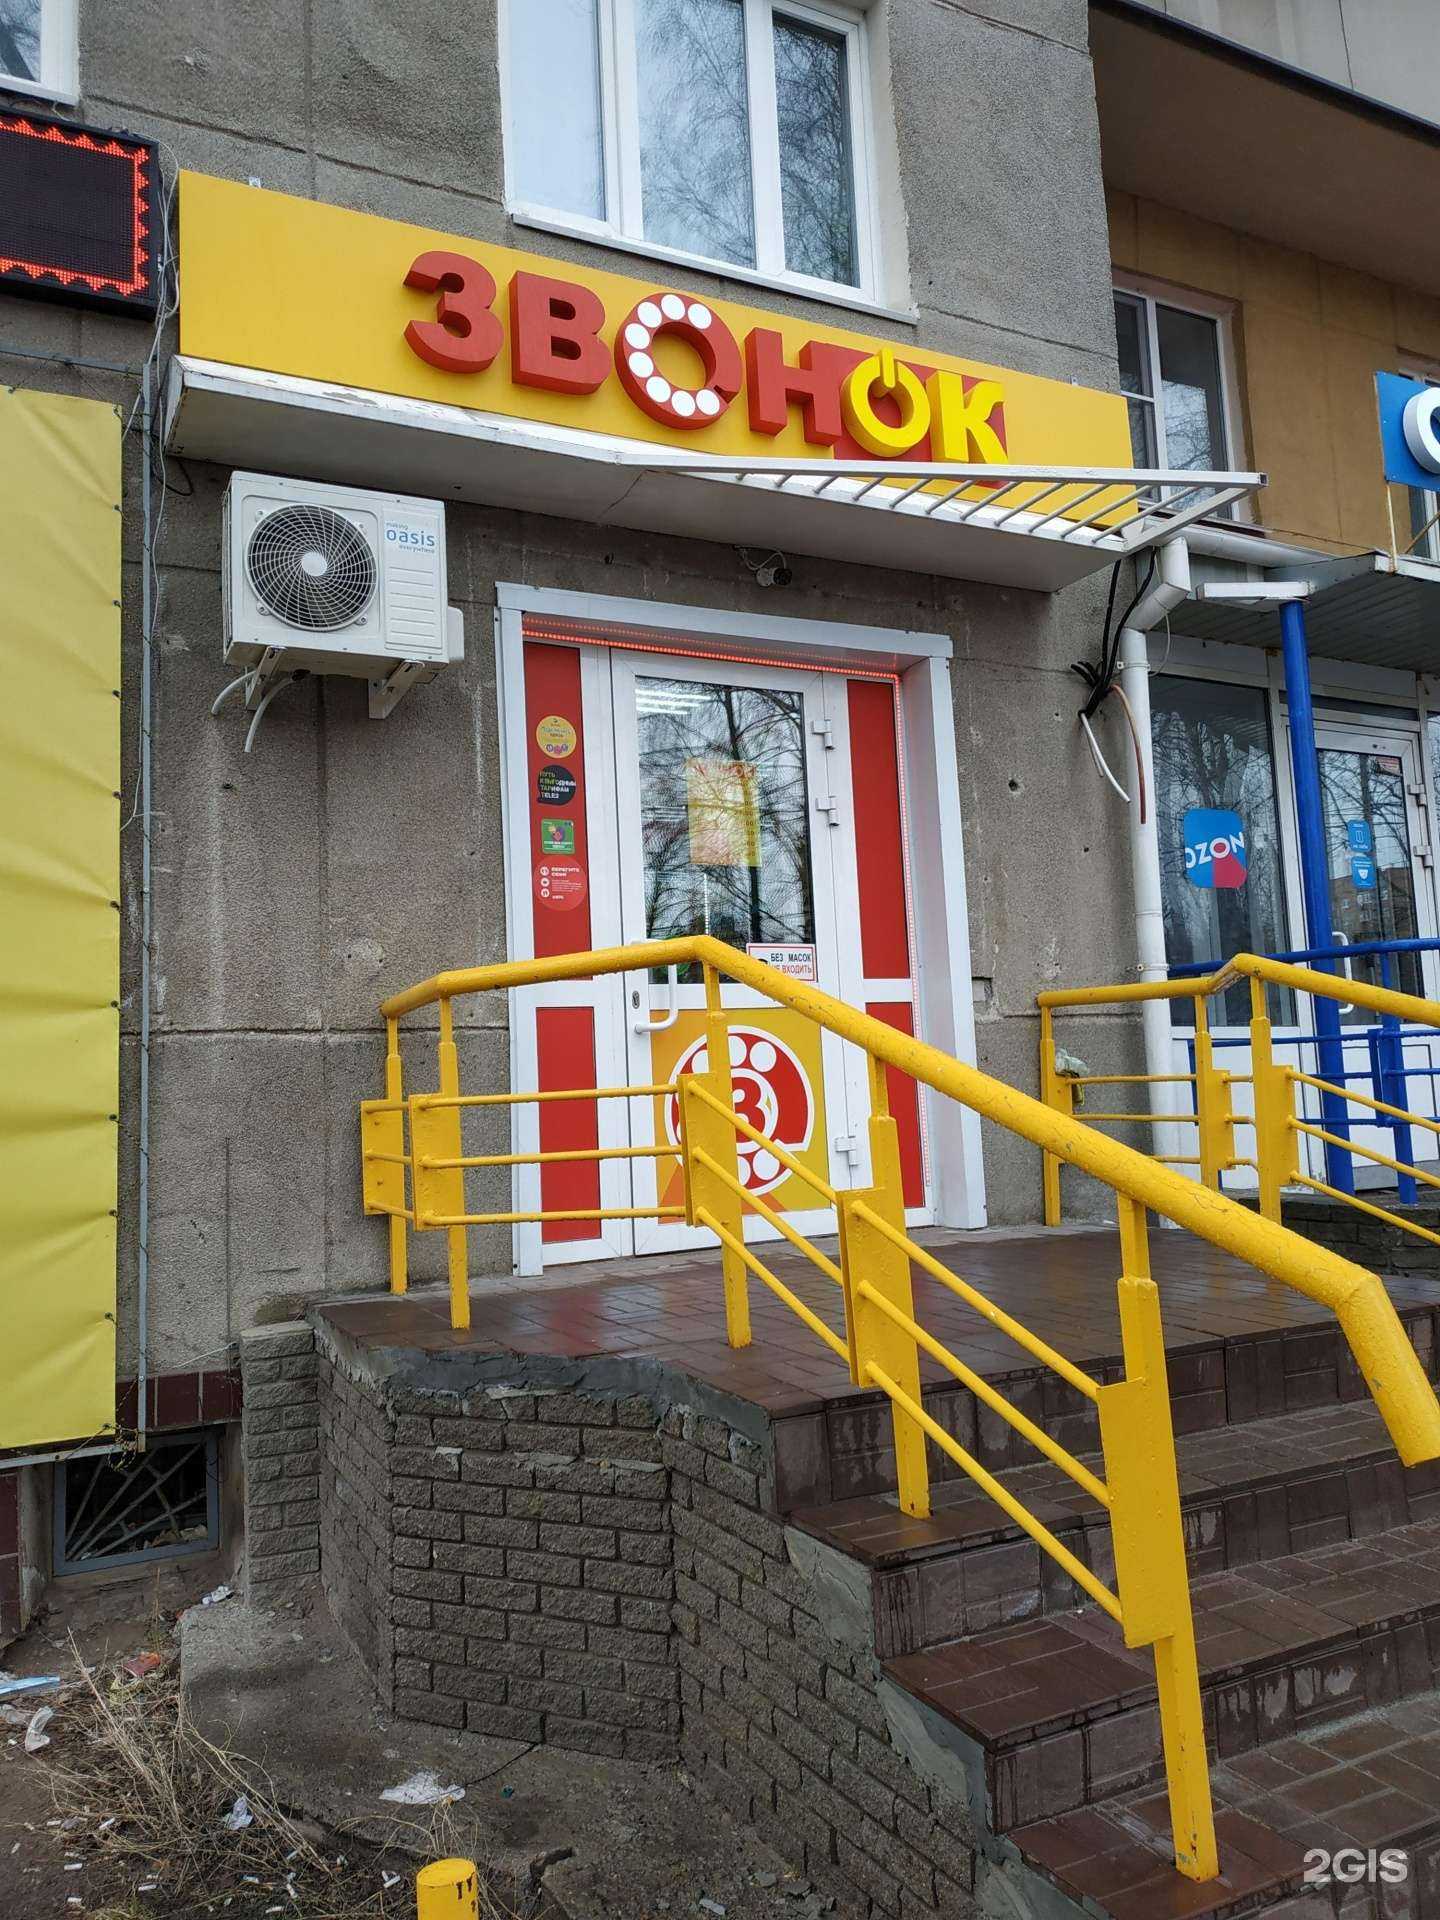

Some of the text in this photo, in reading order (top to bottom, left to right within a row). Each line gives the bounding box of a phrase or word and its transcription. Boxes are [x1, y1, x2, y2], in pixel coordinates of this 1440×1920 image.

[403, 250, 1009, 465] ЗВОНОК
[386, 529, 435, 547] oasis
[1184, 831, 1245, 869] OZON
[770, 953, 812, 962] БЕЗ МАСОК
